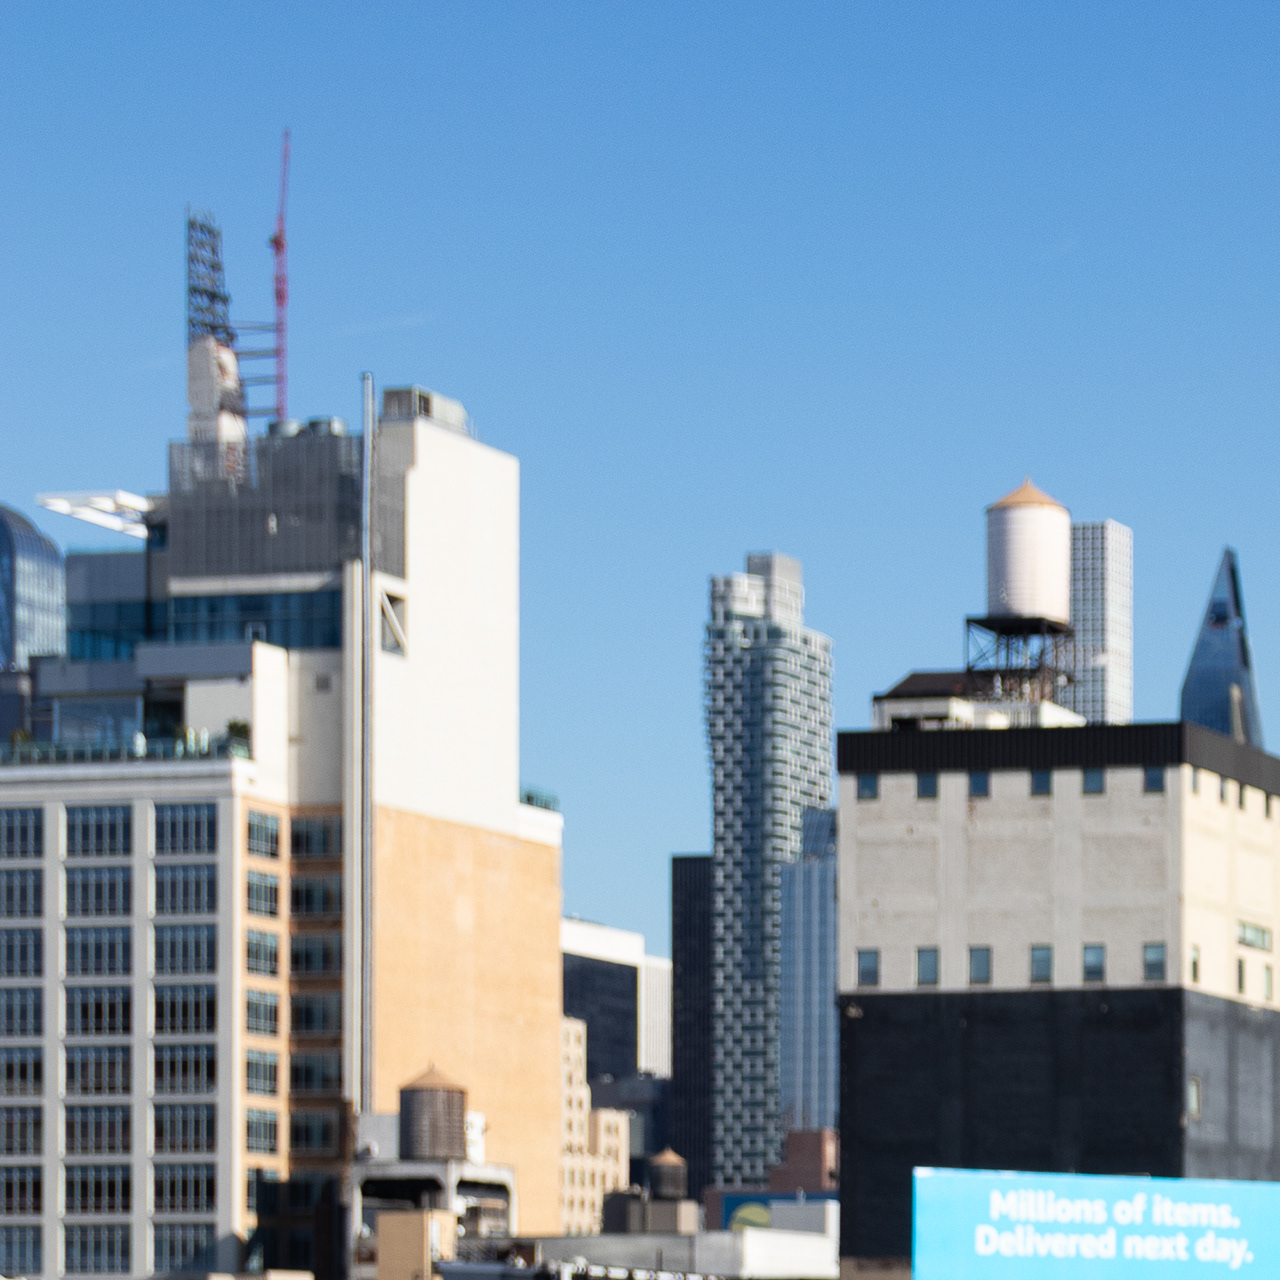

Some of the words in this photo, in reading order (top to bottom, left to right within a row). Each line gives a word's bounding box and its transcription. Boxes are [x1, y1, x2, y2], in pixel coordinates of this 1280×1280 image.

[989, 1189, 1108, 1224] Millions
[1113, 1192, 1148, 1225] of
[1152, 1194, 1242, 1229] items.
[974, 1224, 1117, 1258] Delivered
[1122, 1232, 1190, 1261] next
[1194, 1229, 1255, 1270] day.
